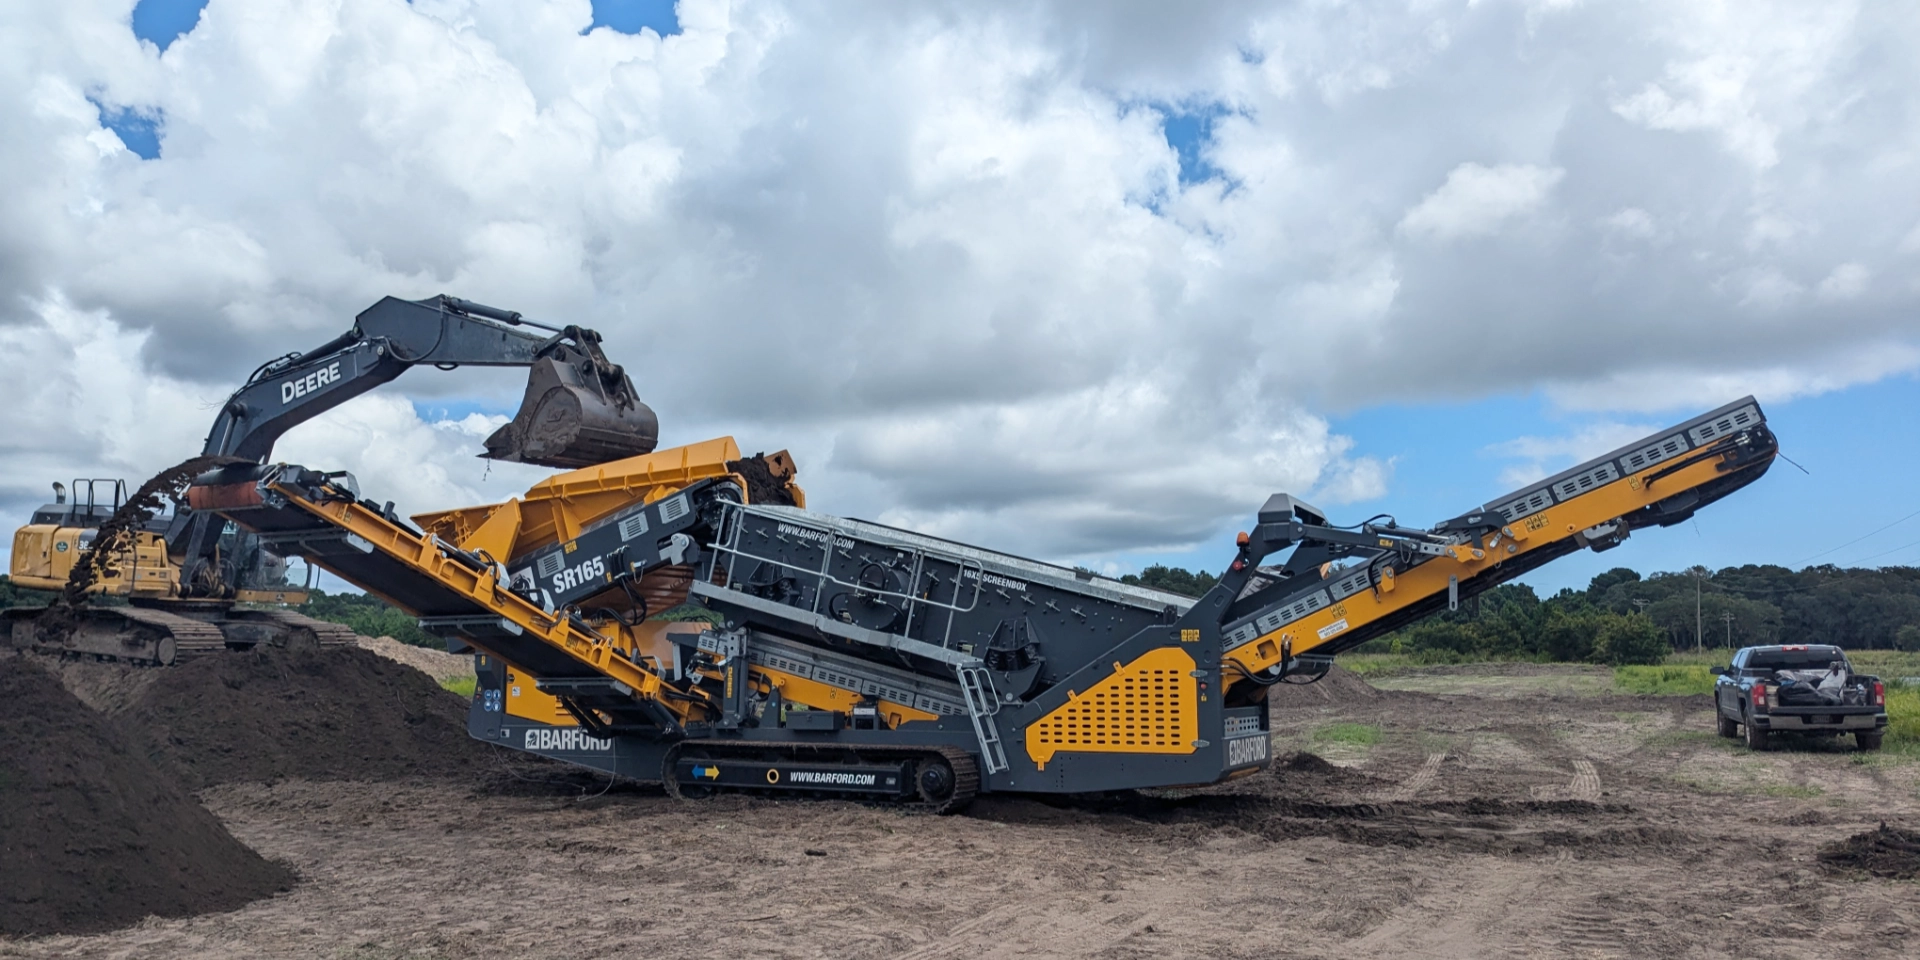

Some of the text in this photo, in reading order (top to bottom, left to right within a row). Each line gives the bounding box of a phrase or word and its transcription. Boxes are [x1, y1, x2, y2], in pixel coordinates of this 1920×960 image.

[282, 361, 341, 404] DEERE
[778, 523, 855, 549] WWW.BARFOD.COM
[553, 555, 604, 594] SR165
[982, 573, 1027, 592] SCREENBOX
[1236, 735, 1267, 765] BARFORD
[790, 772, 876, 785] WWW.BARFORD.COM
